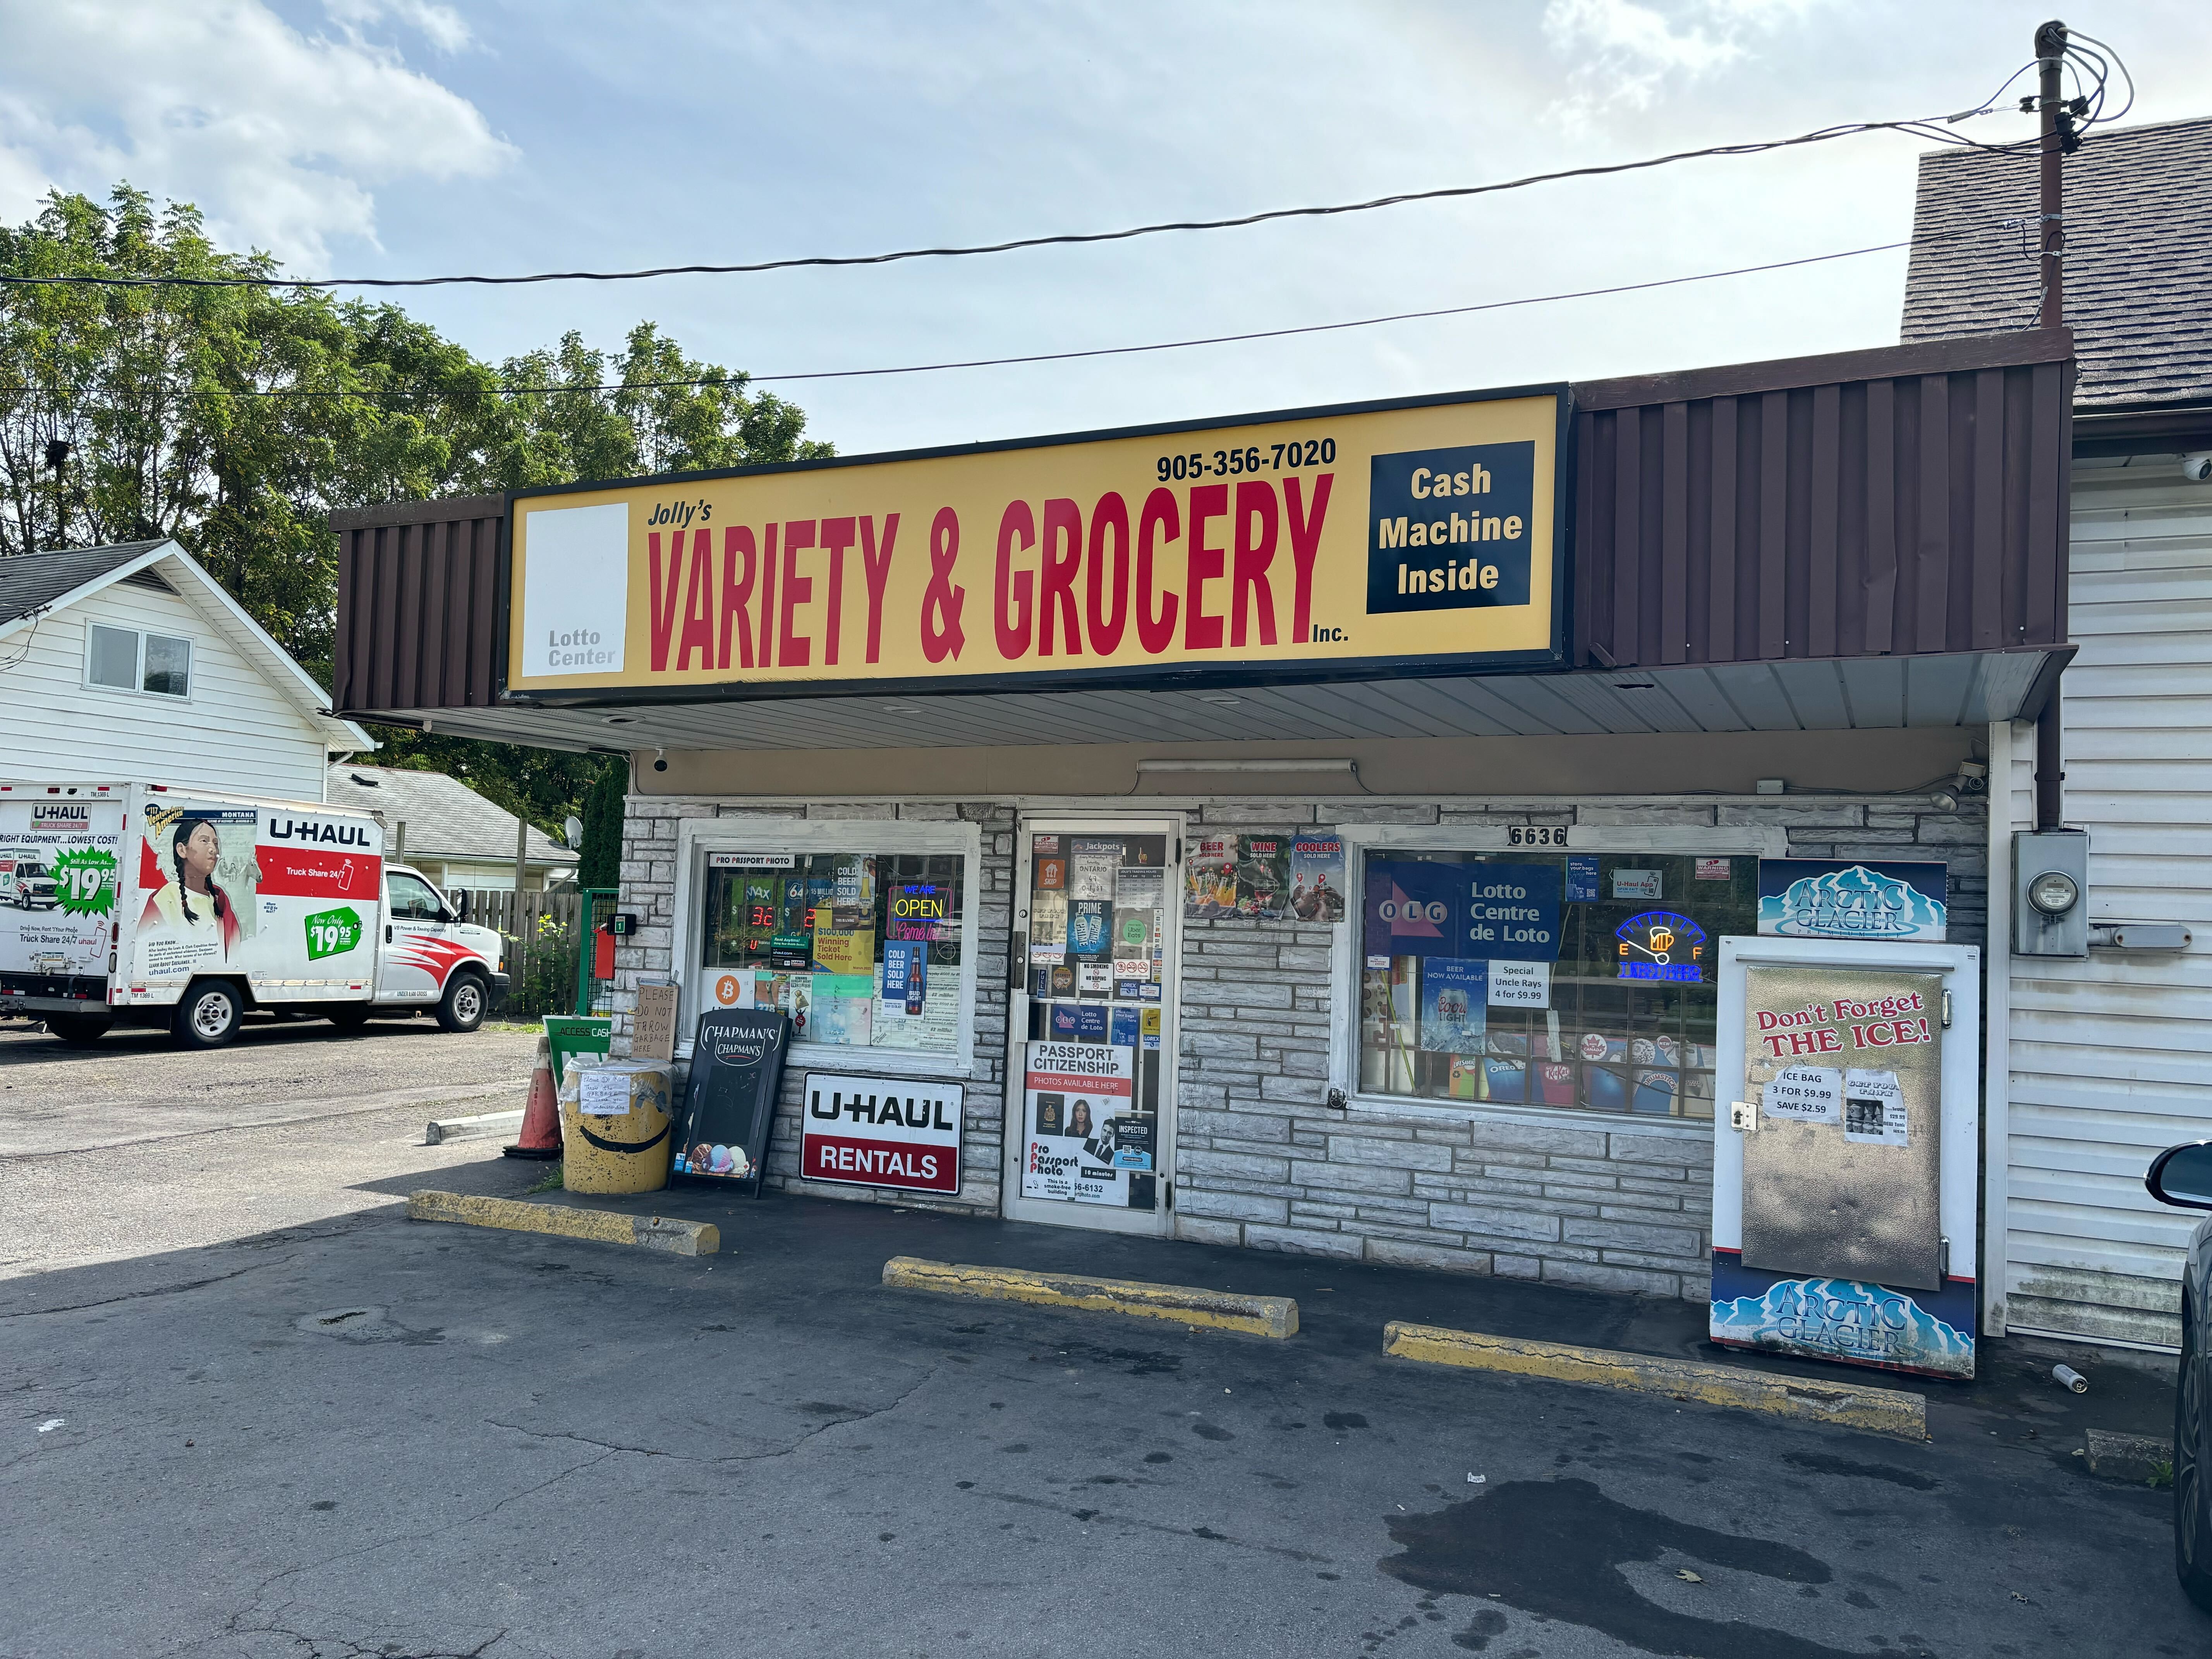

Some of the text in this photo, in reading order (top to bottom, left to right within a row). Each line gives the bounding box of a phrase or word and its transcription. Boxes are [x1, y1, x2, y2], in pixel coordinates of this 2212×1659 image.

[1157, 438, 1336, 482] 905-356-7020
[1411, 463, 1491, 500] Cash
[647, 498, 712, 527] Jolly's
[1379, 510, 1522, 550] Machine
[648, 473, 1334, 673] VARIETY & GROCERY
[1398, 558, 1499, 595] Inside
[549, 629, 600, 647] Lotto
[1313, 623, 1349, 644] Inc.
[548, 648, 616, 666] Center
[34, 806, 88, 819] U-HAUL
[270, 818, 370, 847] U-HAUL
[1510, 828, 1565, 845] 6636
[1085, 842, 1120, 851] Jackpots
[1200, 842, 1224, 851] BEER
[1251, 842, 1277, 852] WINE
[1295, 842, 1340, 852] COOLERS
[286, 867, 345, 879] Truck Share 24/7
[838, 867, 857, 876] COLD
[838, 878, 856, 886] BEER
[837, 888, 856, 896] SOLD
[905, 885, 918, 894] WE
[1471, 881, 1527, 899] Lotto
[1794, 881, 1903, 911] ARCTIC
[837, 897, 855, 906] HERE
[895, 899, 943, 917] OPEN
[1078, 902, 1102, 914] PRIME
[1470, 903, 1540, 922] Centre
[311, 915, 344, 928] Now Only
[1795, 909, 1903, 931] GLACIER
[20, 934, 38, 942] Truck
[40, 935, 60, 943] Share
[62, 935, 77, 945] 24/7
[818, 928, 854, 938] $100,000
[1076, 923, 1088, 947] PRIME
[1090, 922, 1100, 945] PRIME
[1470, 923, 1550, 943] de Loto
[818, 937, 849, 948] Winning
[1620, 943, 1628, 955] E
[888, 950, 905, 959] COLD
[1693, 947, 1702, 960] F
[149, 966, 189, 975] uhaul.com
[888, 960, 904, 969] BEER
[1503, 966, 1534, 976] Special
[888, 970, 904, 979] SOLD
[1445, 974, 1483, 982] AVAILABLE
[887, 980, 904, 989] HERE
[1495, 978, 1542, 989] Uncle Rays
[639, 987, 674, 1001] PLEASE
[1495, 990, 1542, 1000] 4 for $9.99
[635, 1004, 672, 1017] DO NOT
[1438, 996, 1467, 1013] Coors
[1756, 990, 1923, 1032] Don't Forget
[1439, 1012, 1465, 1023] LIGHT
[634, 1033, 670, 1043] GARBAGE
[705, 1025, 776, 1040] CHAPMAN'S
[1762, 1018, 1931, 1058] THE ICE!
[717, 1044, 762, 1056] CHAPMAN'S
[1039, 1045, 1114, 1061] PASSPORT
[1034, 1058, 1119, 1074] CITIZENSHIP
[1489, 1065, 1515, 1073] OREO
[1034, 1077, 1119, 1090] PHOTOS AVAILABLE HERE
[1783, 1072, 1822, 1084] ICE BAG
[1772, 1085, 1831, 1099] 3 FOR $9.99
[1859, 1089, 1893, 1097] TANK
[811, 1090, 953, 1131] U-HAUL
[1776, 1101, 1826, 1115] SAVE $2.59
[1119, 1125, 1148, 1134] INSPECTED
[1031, 1142, 1049, 1154] Pro
[820, 1145, 938, 1179] RENTALS
[1030, 1152, 1079, 1168] Passport
[1775, 1283, 1905, 1331] ARCTIC
[1776, 1316, 1902, 1355] GLACIER
